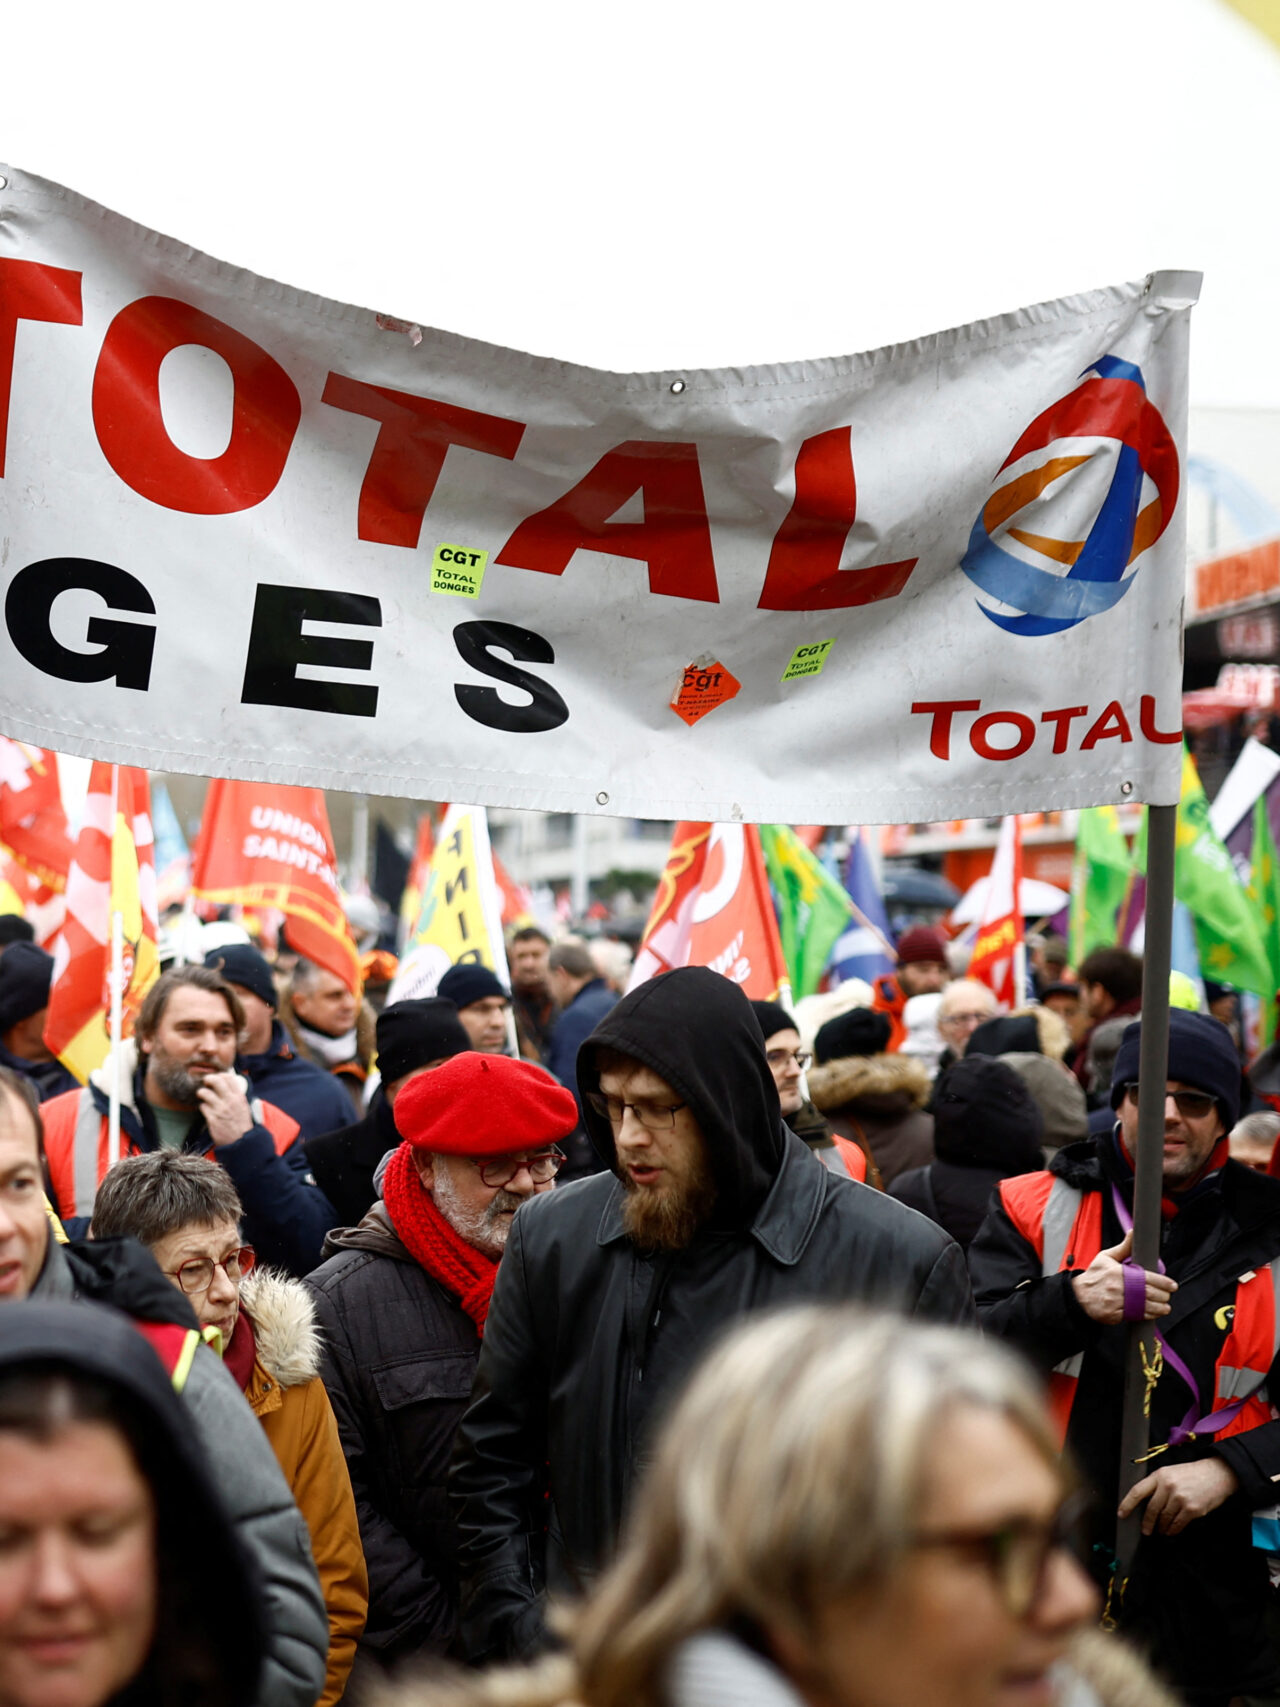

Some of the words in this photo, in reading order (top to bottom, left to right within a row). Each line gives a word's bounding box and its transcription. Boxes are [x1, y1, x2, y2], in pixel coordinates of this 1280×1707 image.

[439, 548, 481, 567] CGT
[435, 568, 477, 585] TOTAL
[433, 580, 475, 594] DONGES
[797, 642, 831, 658] CGT
[911, 694, 1183, 762] TOTAL
